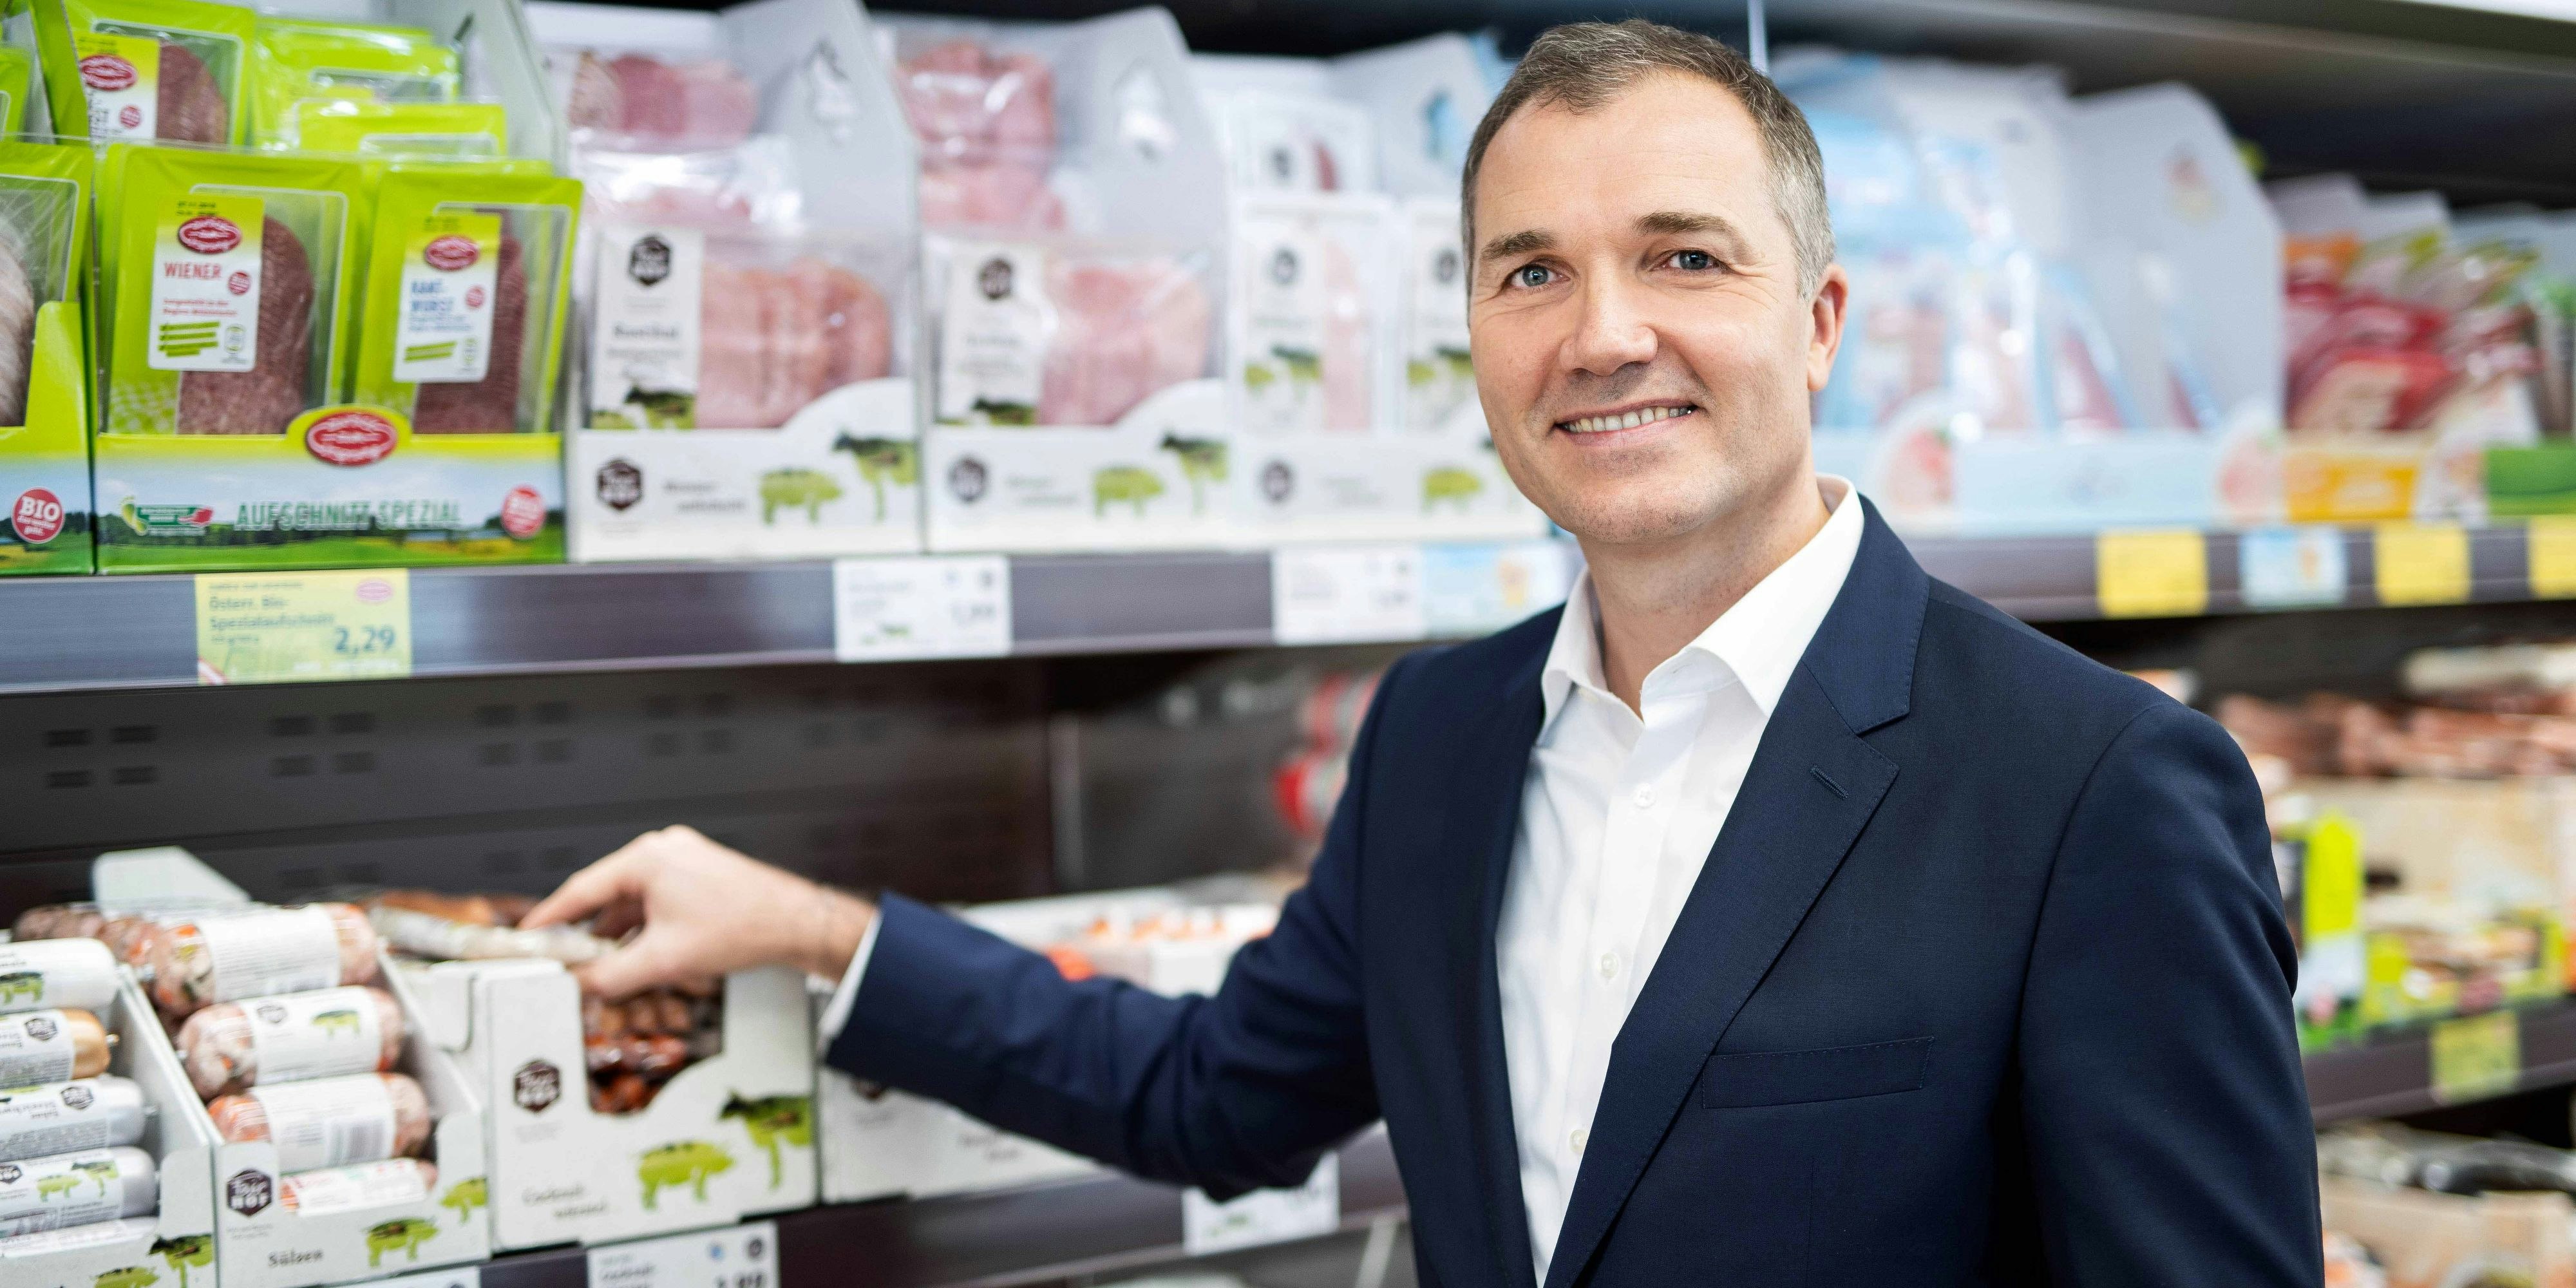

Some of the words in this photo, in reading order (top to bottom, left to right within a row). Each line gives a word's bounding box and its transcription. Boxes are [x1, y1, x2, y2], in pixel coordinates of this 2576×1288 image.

[164, 262, 222, 279] WIENER
[19, 495, 61, 522] BIO
[234, 501, 372, 531] AUFSCHNITT
[375, 499, 463, 530] SPEZIAL
[334, 625, 396, 655] 2,29
